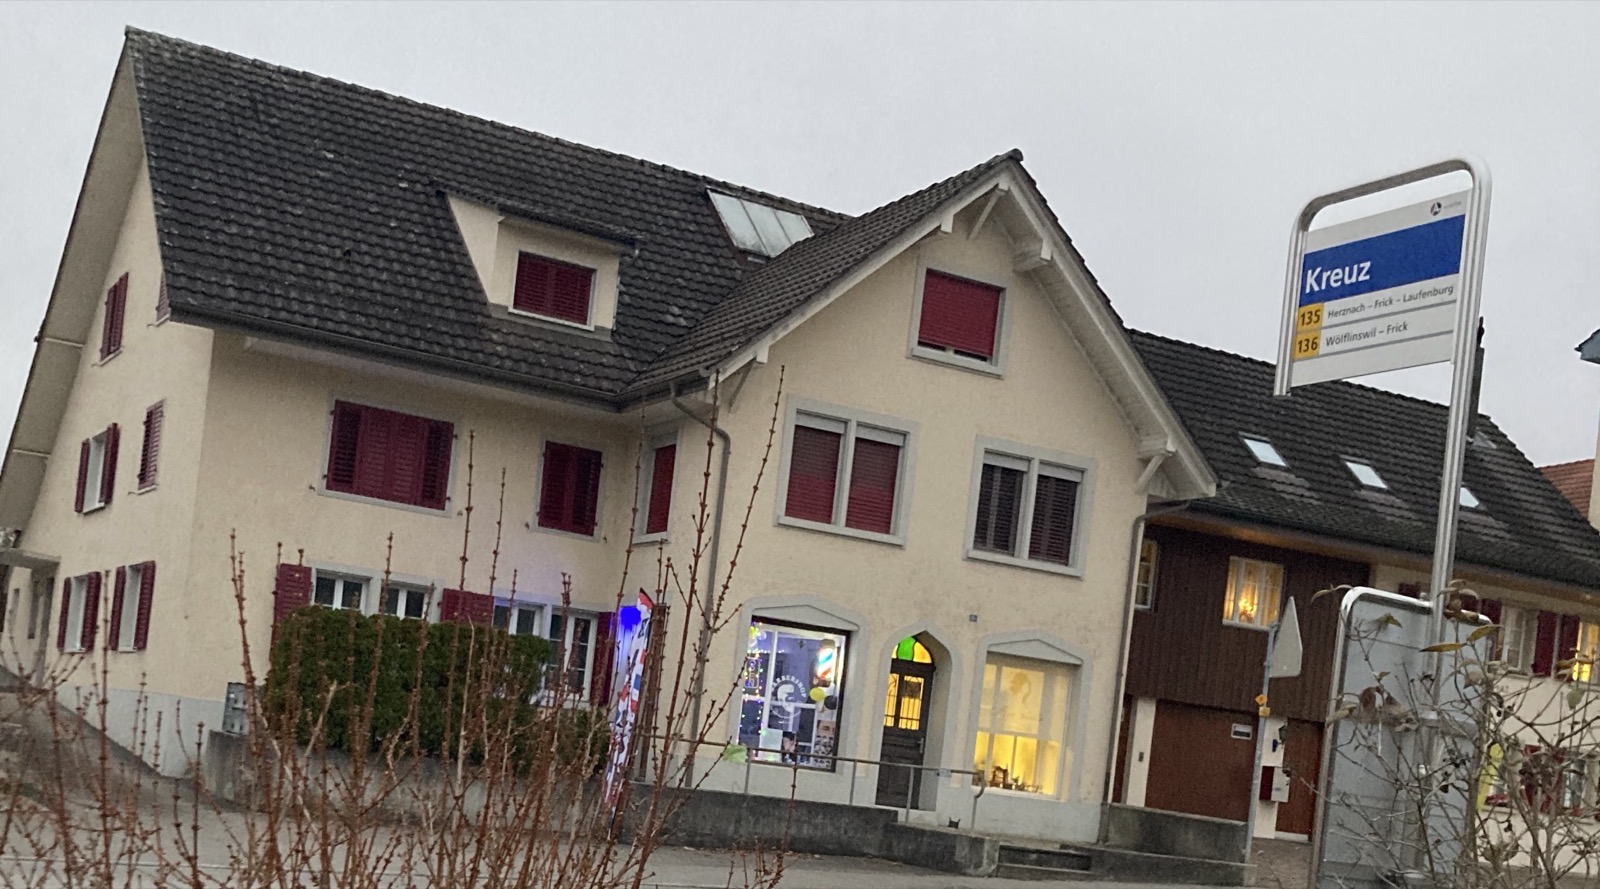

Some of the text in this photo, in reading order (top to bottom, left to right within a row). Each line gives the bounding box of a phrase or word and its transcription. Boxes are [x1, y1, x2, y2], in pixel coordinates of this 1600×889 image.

[1305, 261, 1371, 293] Kreuz
[1300, 309, 1321, 326] 135
[1328, 303, 1365, 318] Herznach
[1374, 299, 1393, 309] Frick
[1403, 285, 1454, 303] Laufenburg
[1298, 337, 1318, 353] 136
[1326, 329, 1376, 347] Wölflinswil
[1386, 321, 1408, 335] Frick
